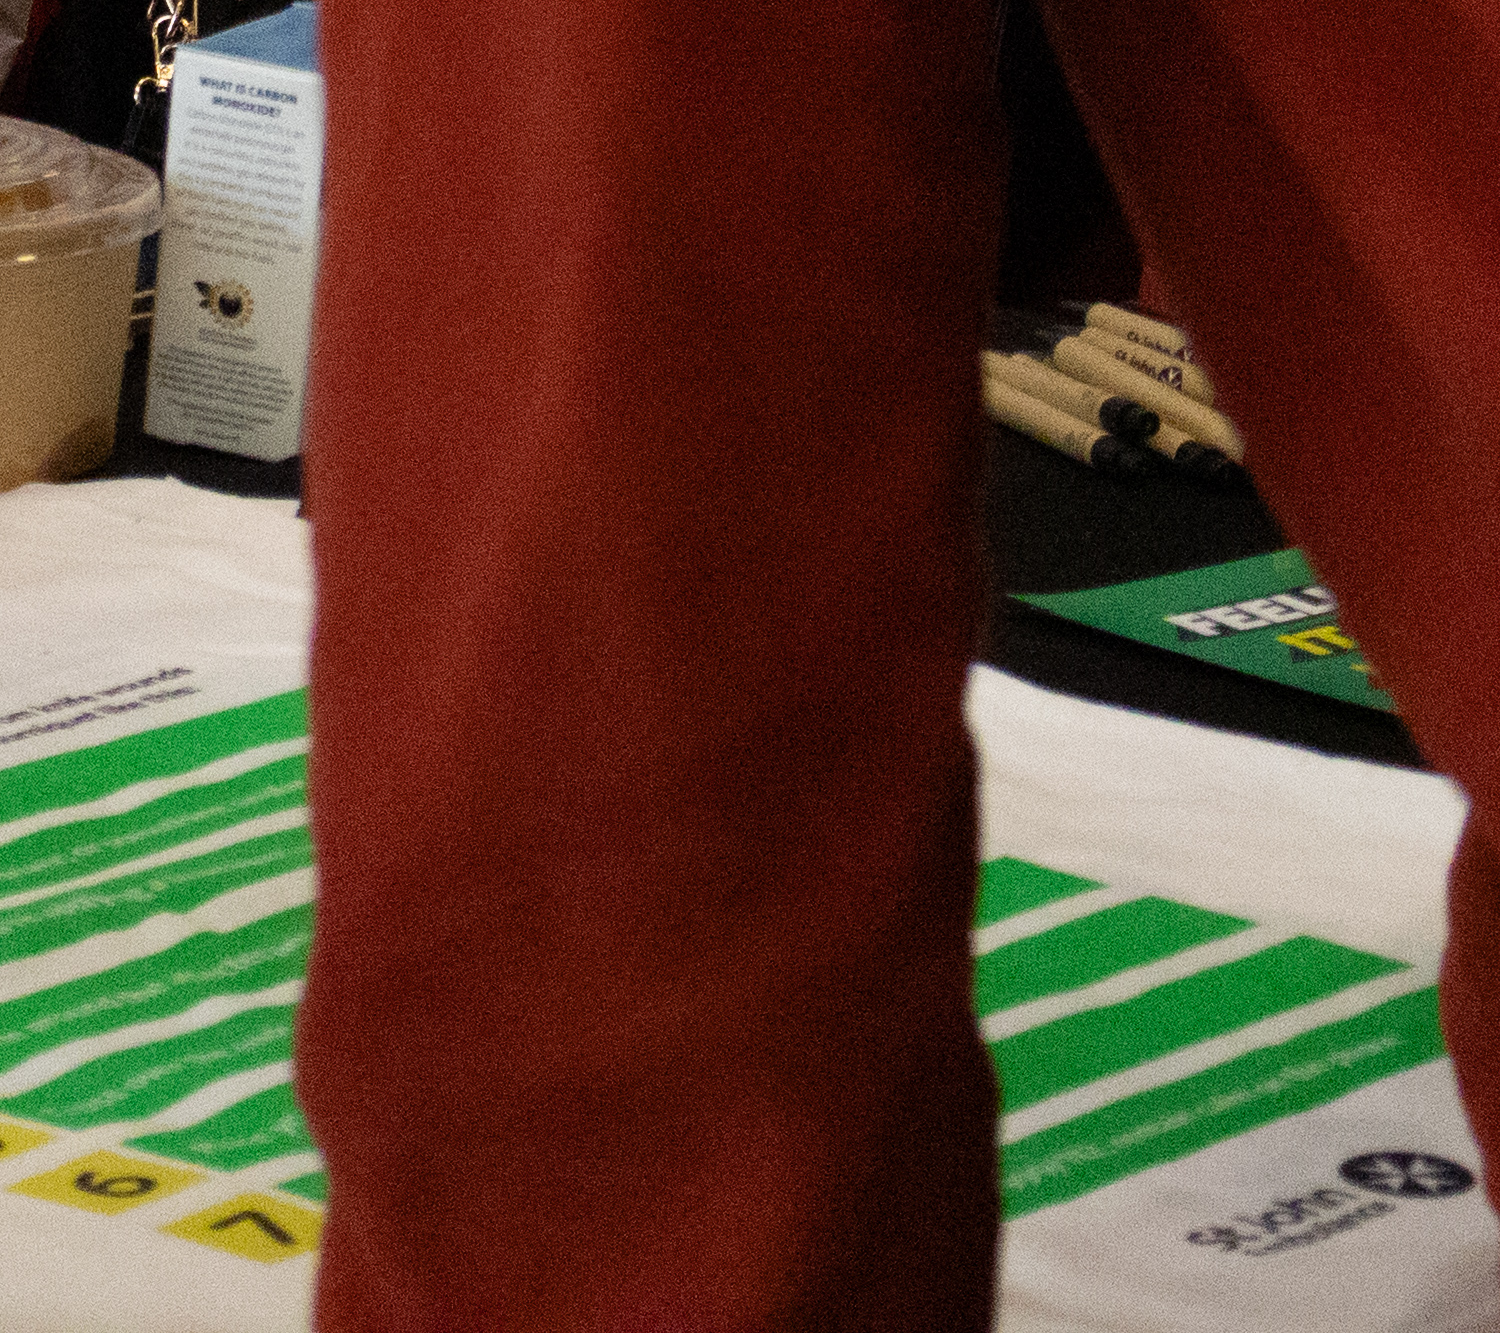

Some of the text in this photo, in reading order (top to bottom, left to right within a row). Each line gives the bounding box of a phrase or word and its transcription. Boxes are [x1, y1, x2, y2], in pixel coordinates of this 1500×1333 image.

[248, 85, 298, 105] CARBON
[75, 1168, 160, 1201] 6
[207, 1208, 300, 1251] 7
